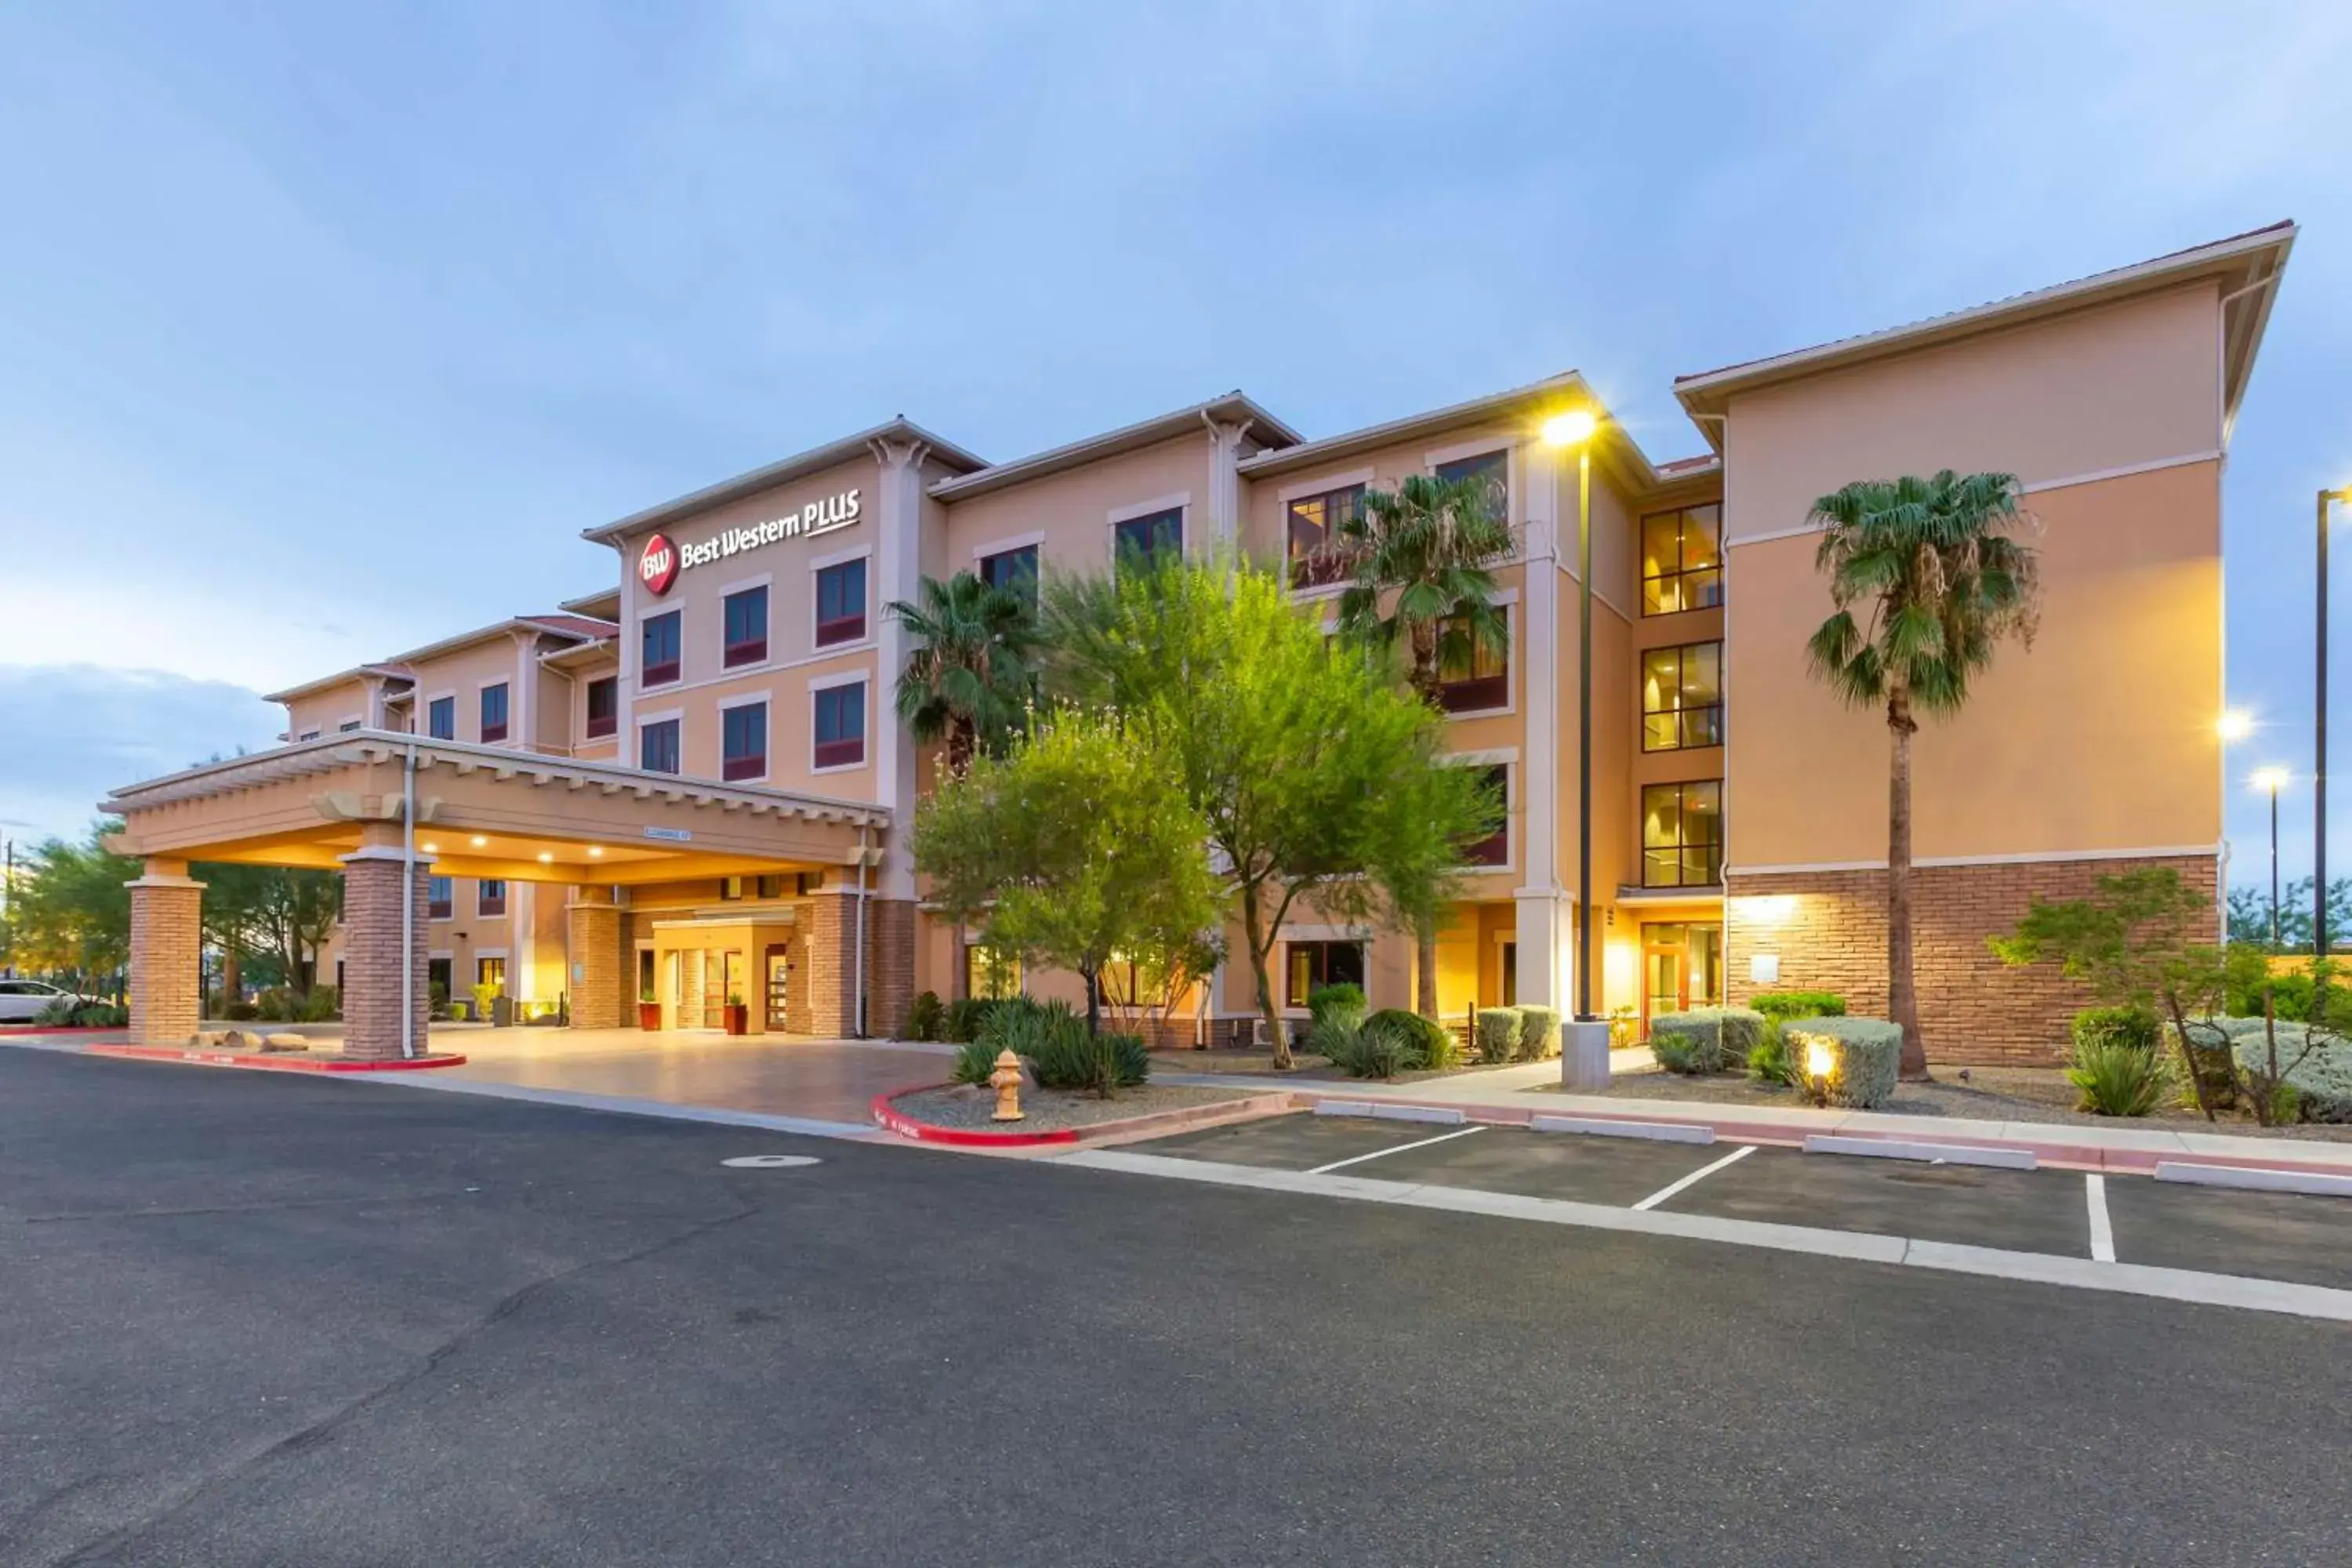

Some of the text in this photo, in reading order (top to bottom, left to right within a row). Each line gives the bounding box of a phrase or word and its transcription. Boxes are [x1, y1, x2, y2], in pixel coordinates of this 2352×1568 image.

[681, 488, 859, 568] Best Western PLUS
[644, 548, 670, 581] BW
